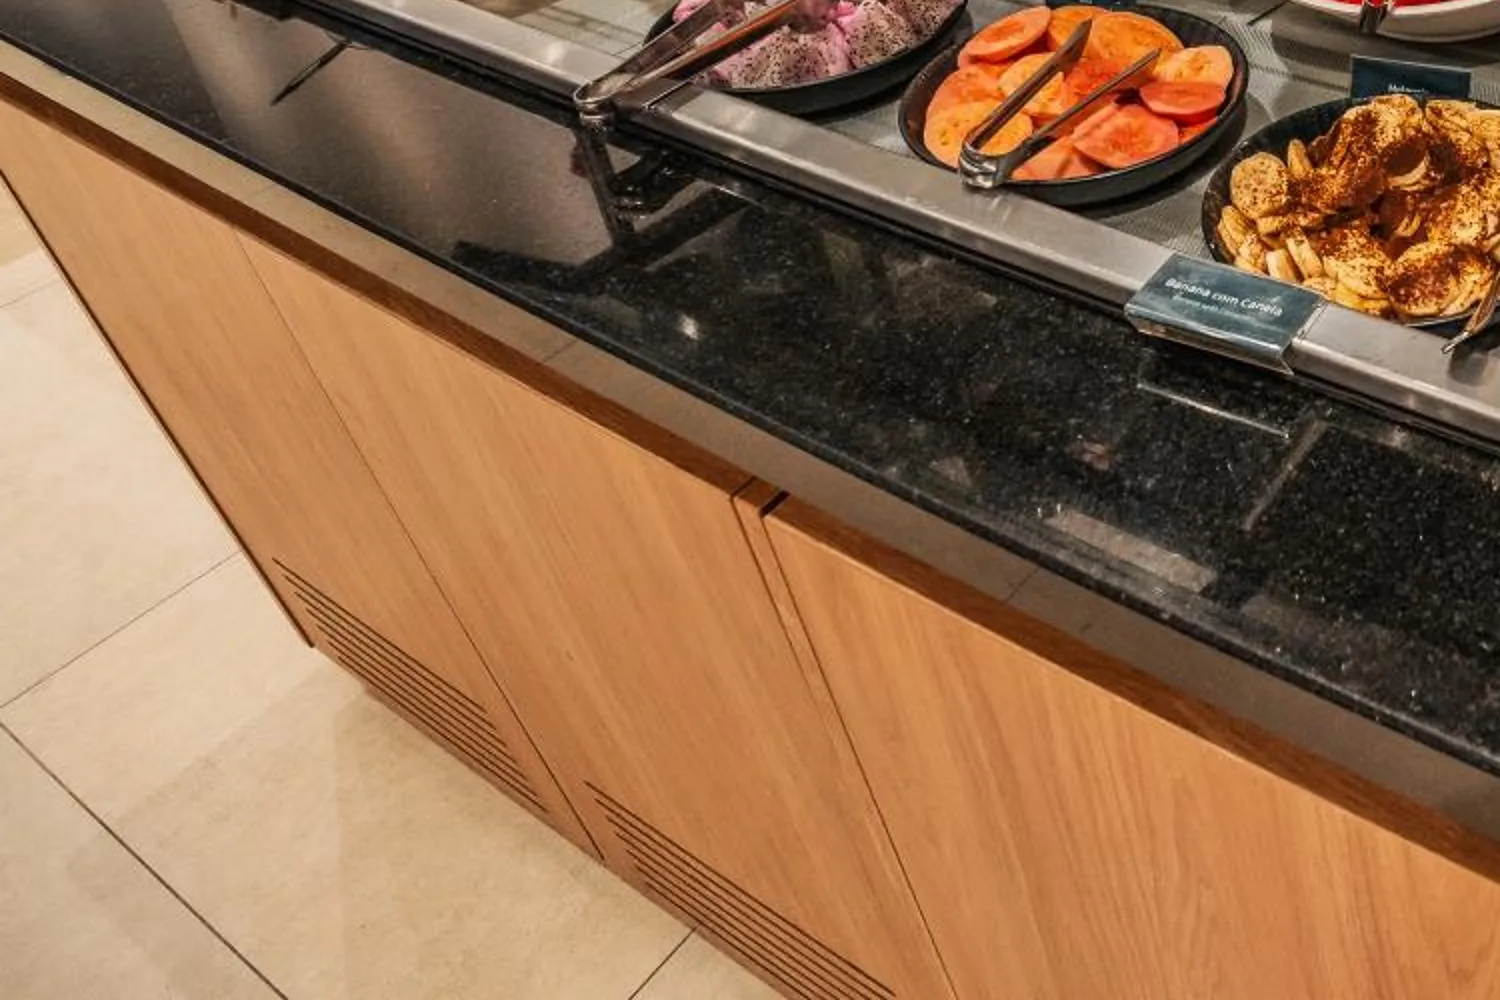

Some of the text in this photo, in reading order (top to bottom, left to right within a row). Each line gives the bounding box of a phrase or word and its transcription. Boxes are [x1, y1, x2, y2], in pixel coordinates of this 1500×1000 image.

[1164, 277, 1211, 298] Banana
[1211, 293, 1239, 305] com
[1240, 296, 1284, 317] Canela
